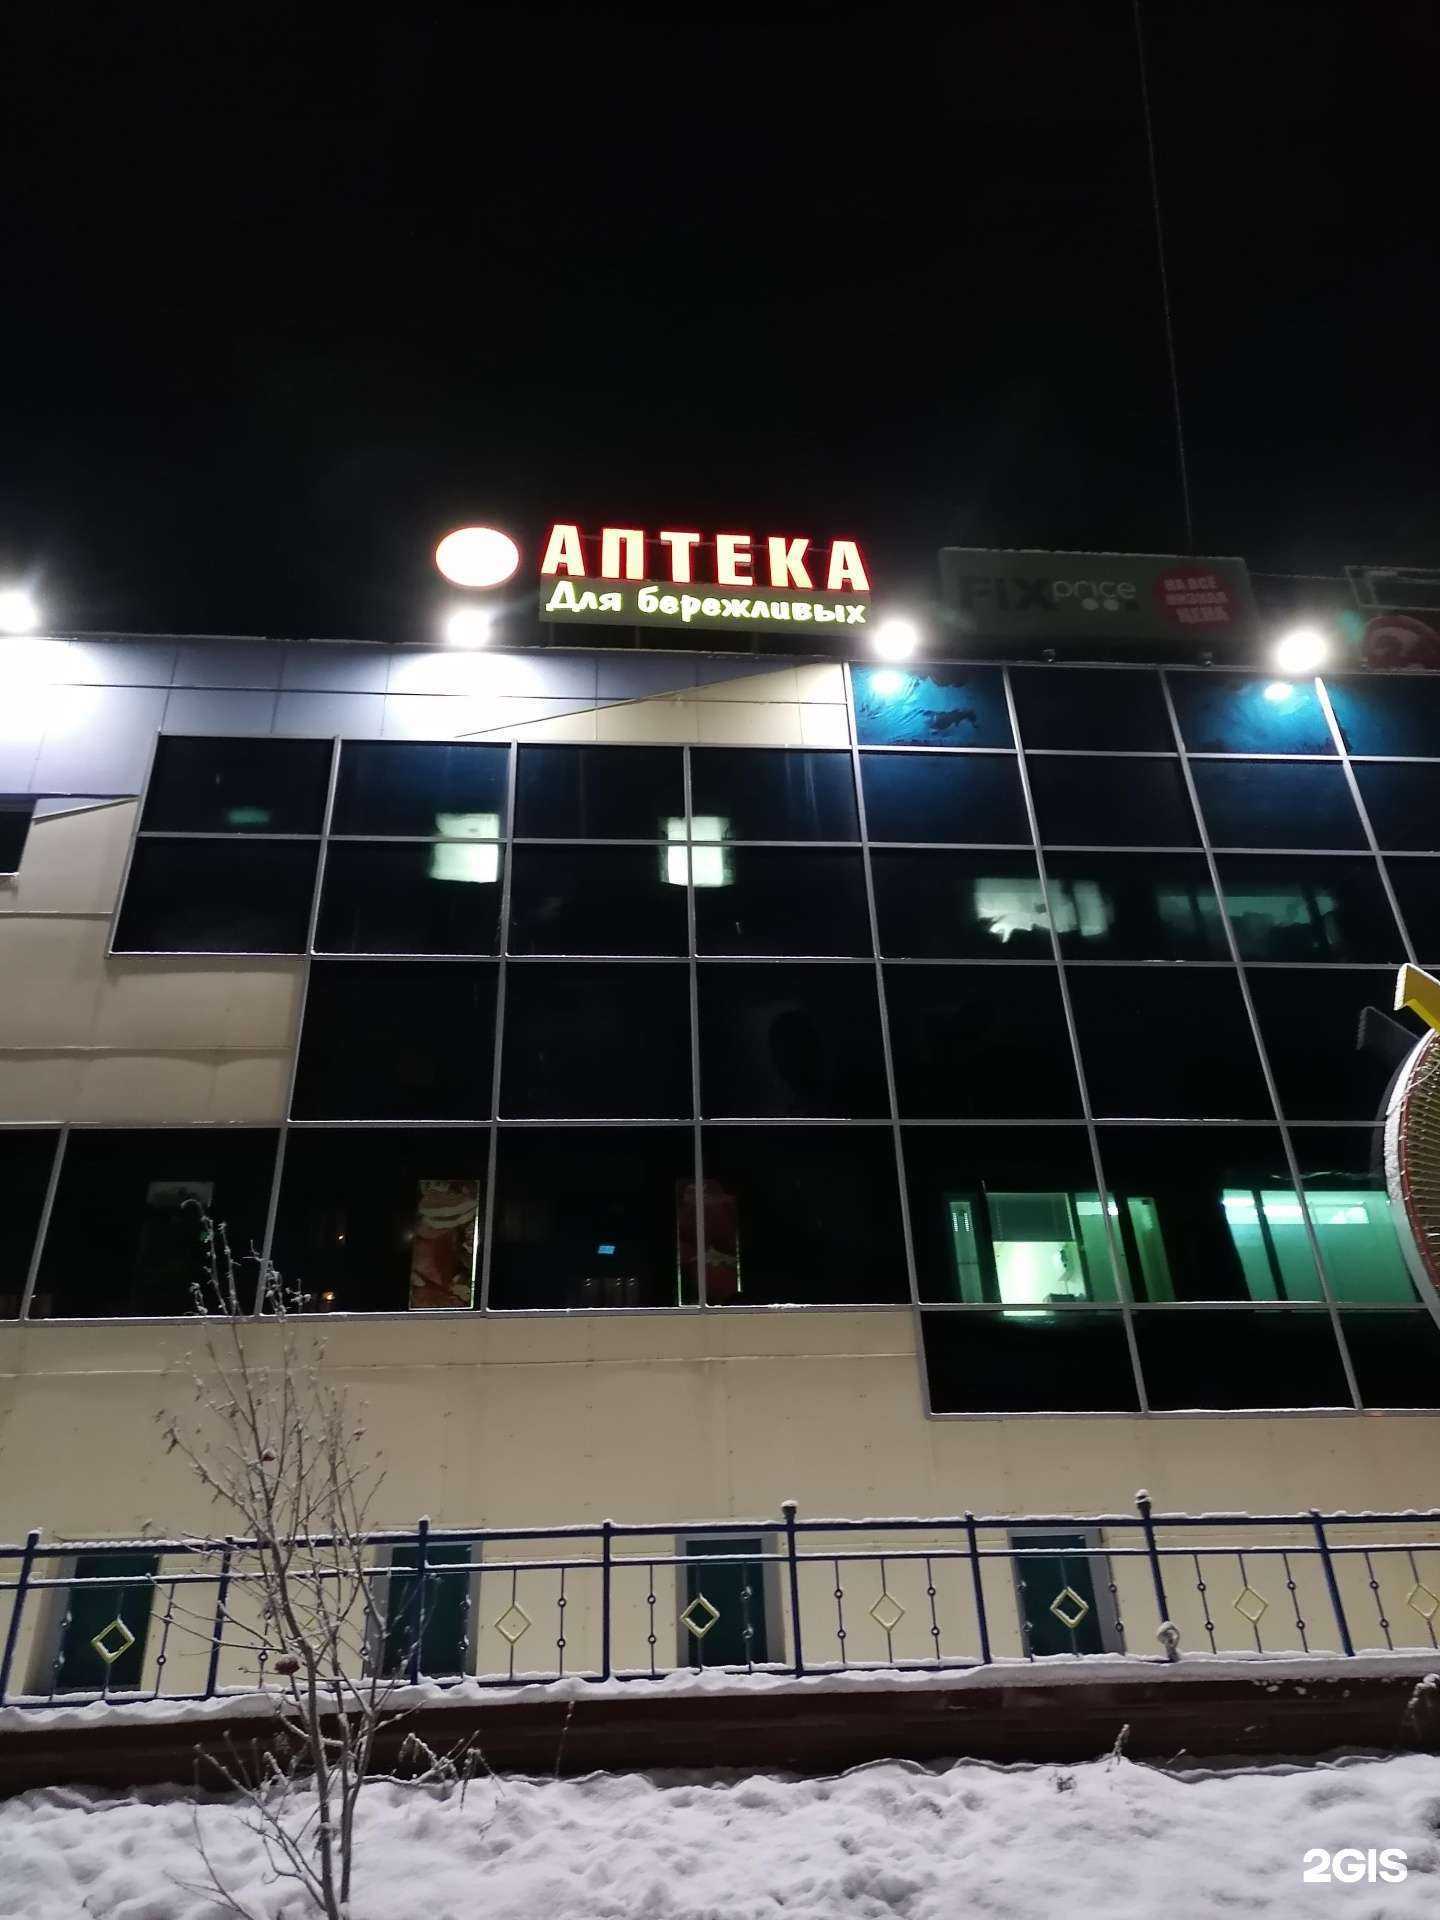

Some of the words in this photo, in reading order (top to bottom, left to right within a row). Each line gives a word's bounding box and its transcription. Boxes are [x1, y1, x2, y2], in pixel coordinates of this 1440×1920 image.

[541, 523, 870, 591] АПТЕКА
[545, 580, 622, 612] Для
[637, 585, 867, 623] бережливых
[1053, 579, 1137, 603] price
